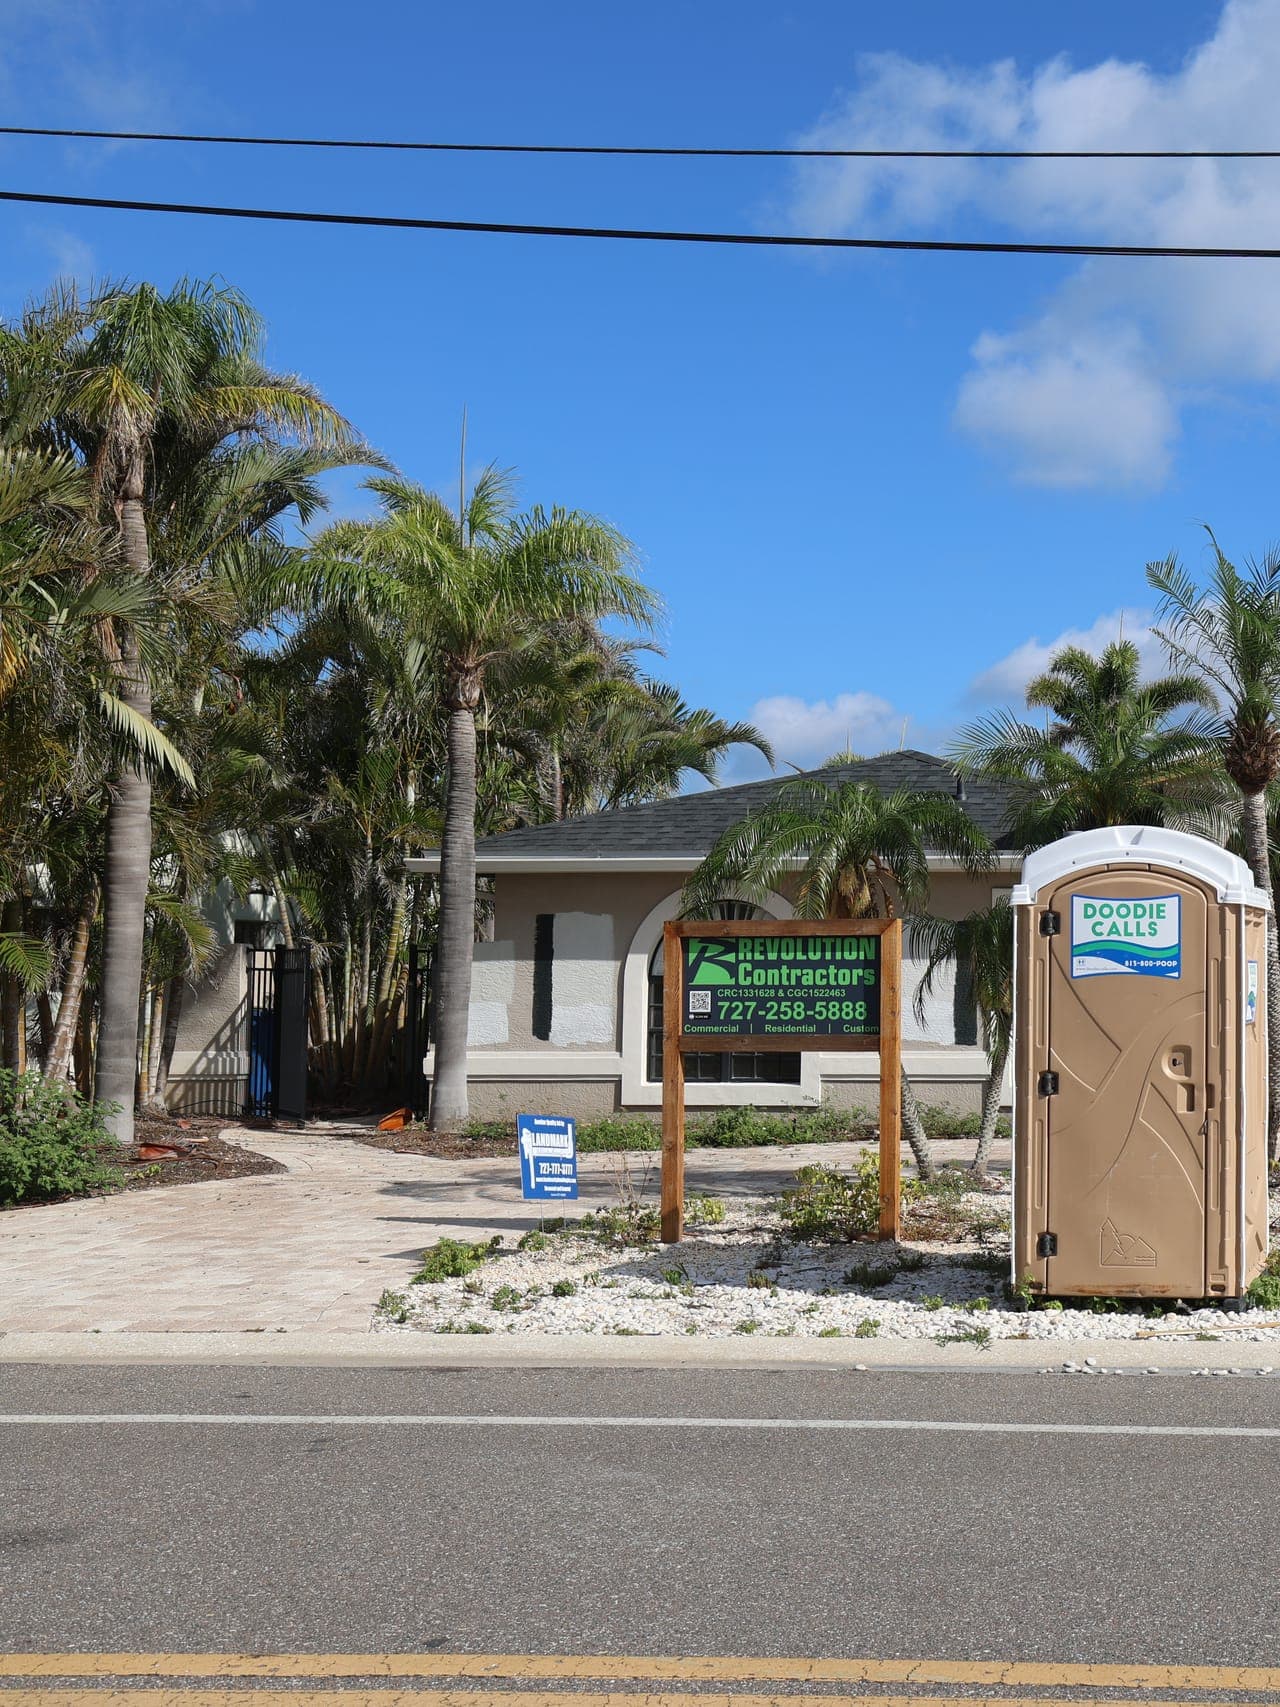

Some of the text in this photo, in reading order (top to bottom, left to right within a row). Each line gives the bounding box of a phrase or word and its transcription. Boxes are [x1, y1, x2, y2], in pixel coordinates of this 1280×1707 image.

[1083, 903, 1167, 920] DOODIE
[1091, 920, 1158, 937] CALLS
[738, 937, 876, 961] REVOLUTION
[738, 962, 876, 986] Contractors
[717, 988, 846, 997] CRC1331628 & CGC1522463
[717, 1001, 867, 1020] 727-258-5888
[684, 1024, 879, 1033] Commercial Residential Custom
